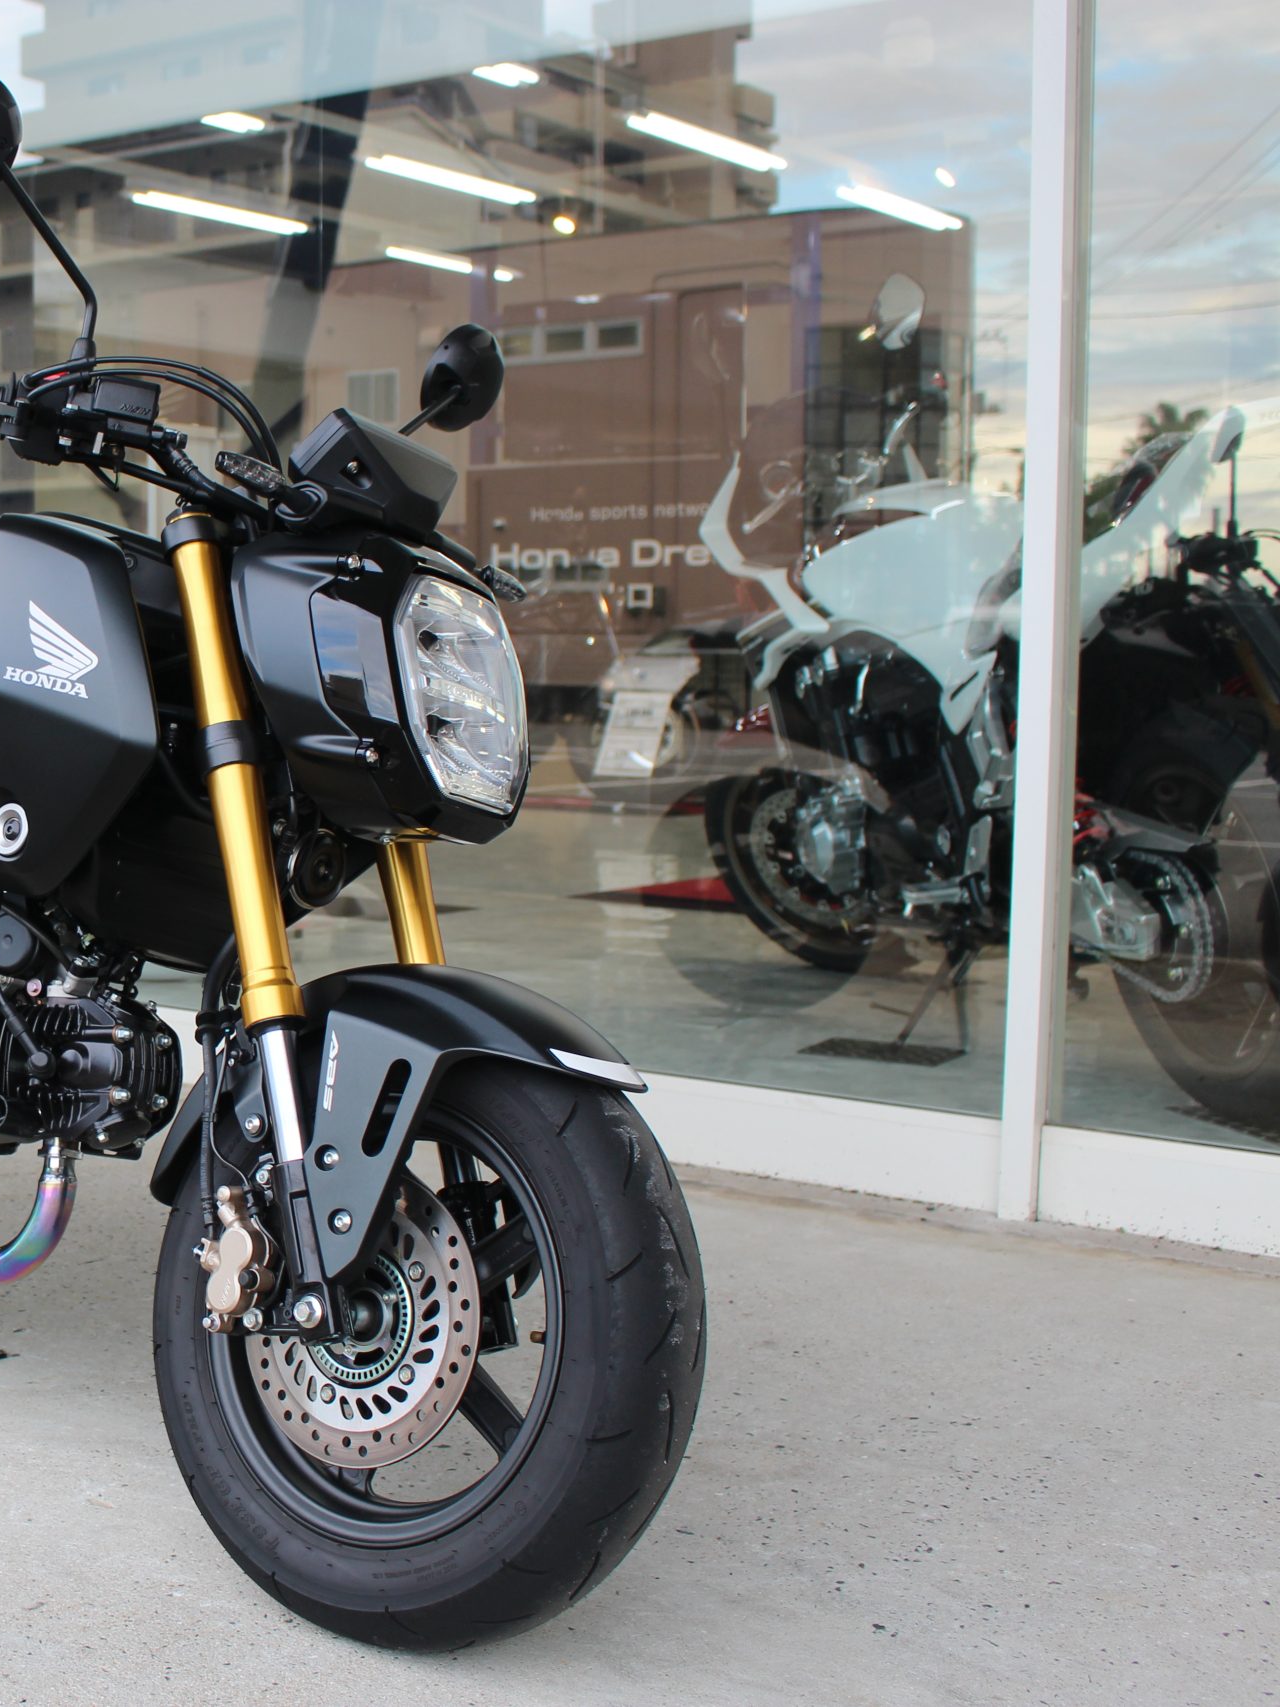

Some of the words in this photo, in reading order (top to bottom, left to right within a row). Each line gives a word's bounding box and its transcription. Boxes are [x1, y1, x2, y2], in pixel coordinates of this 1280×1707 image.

[588, 503, 648, 522] sports
[653, 502, 710, 519] netwo
[630, 538, 714, 568] Dre
[3, 666, 89, 699] HONDA
[322, 1029, 340, 1112] ABS
